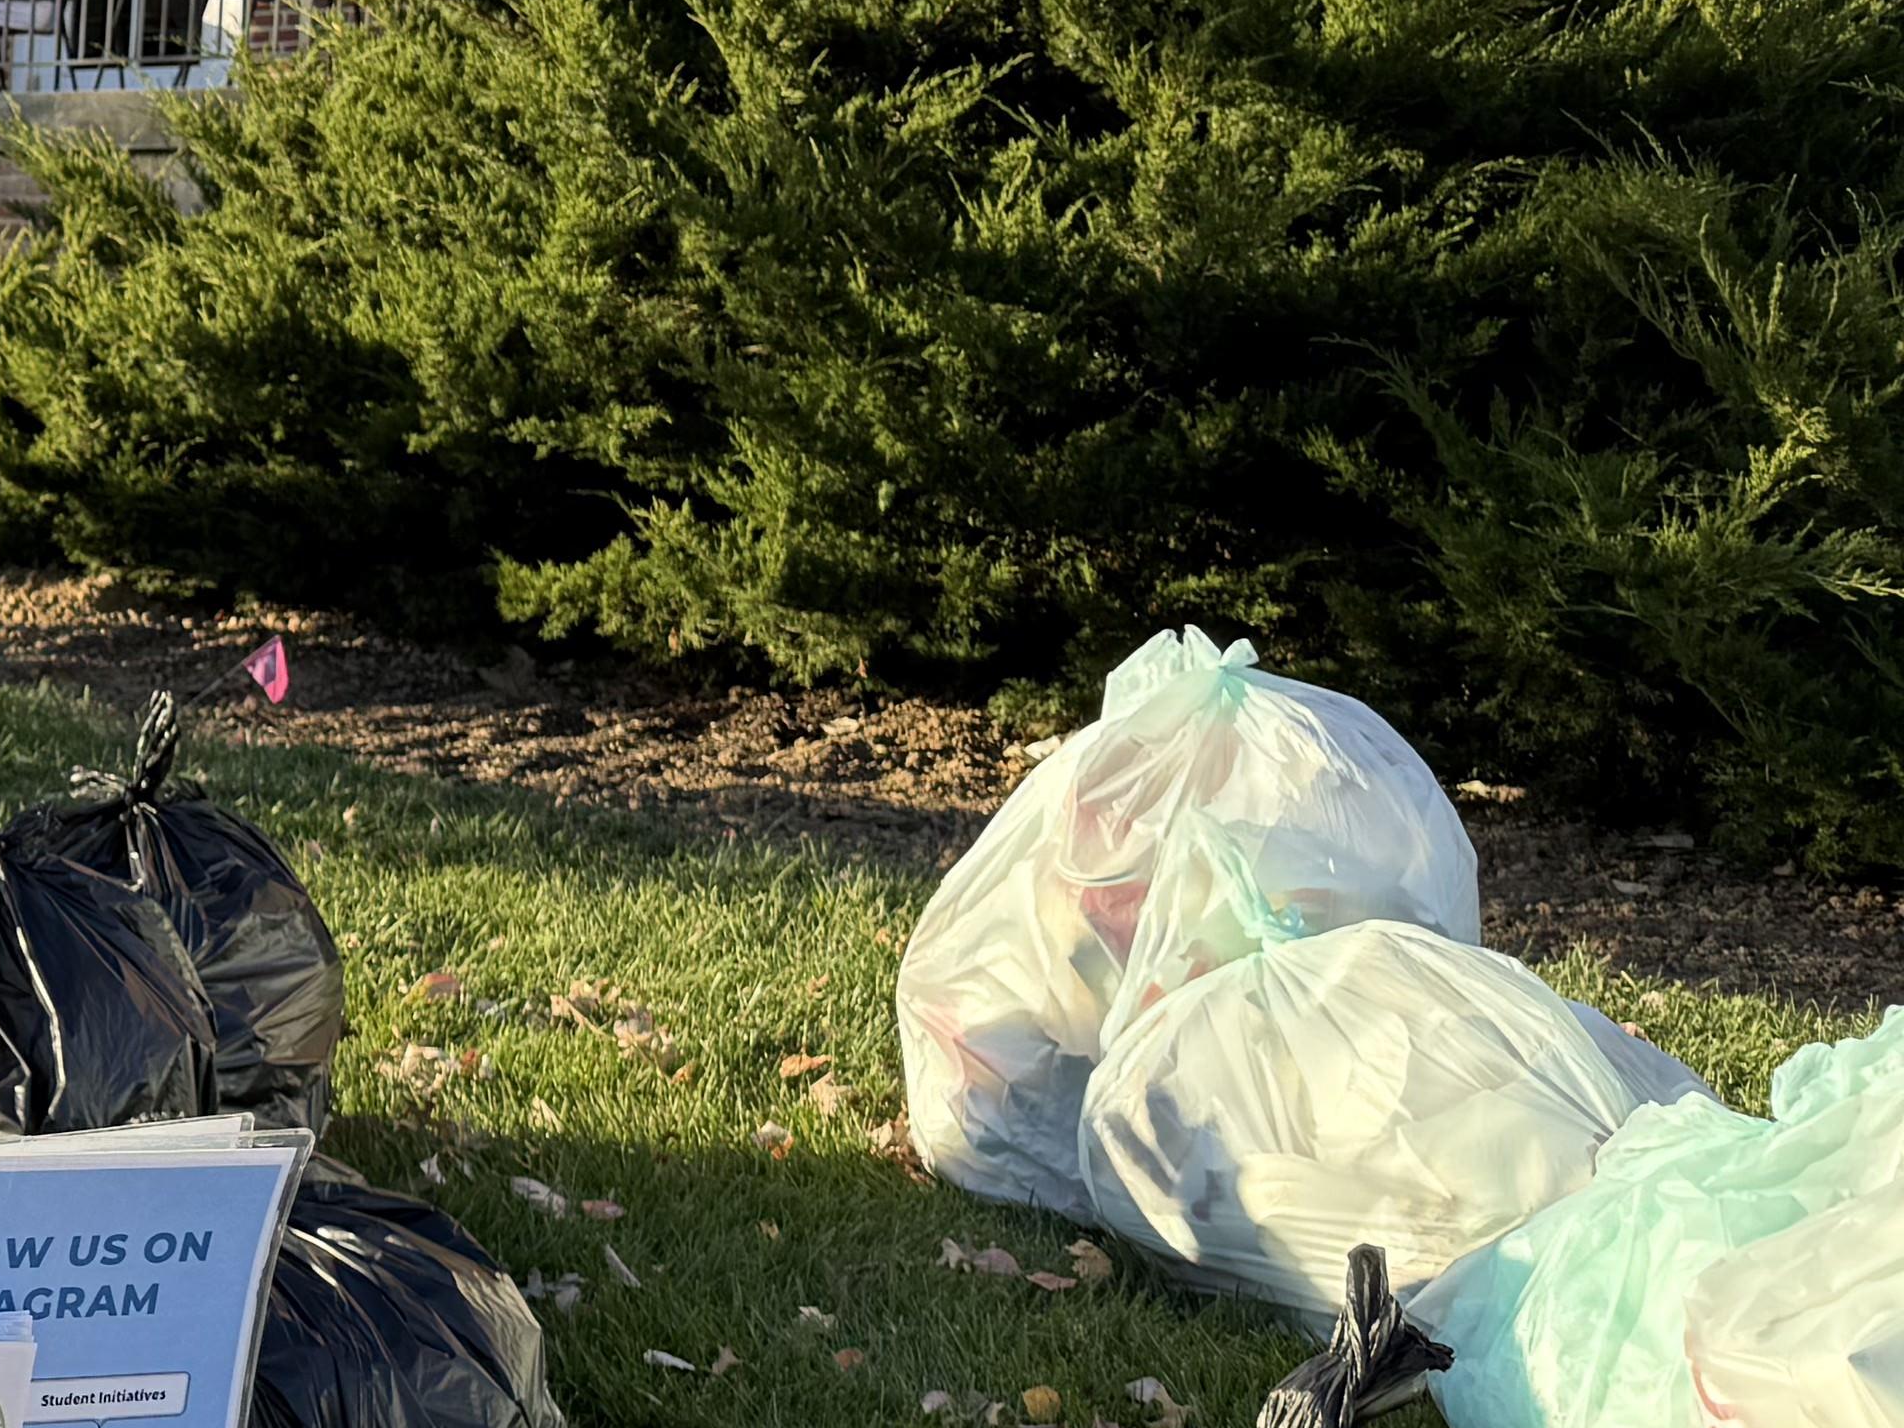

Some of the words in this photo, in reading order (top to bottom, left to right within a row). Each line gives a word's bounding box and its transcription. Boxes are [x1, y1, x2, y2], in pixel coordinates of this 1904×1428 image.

[69, 1234, 128, 1266] US
[144, 1231, 213, 1262] ON
[41, 1391, 95, 1407] Student
[98, 1388, 166, 1405] Initiatives
